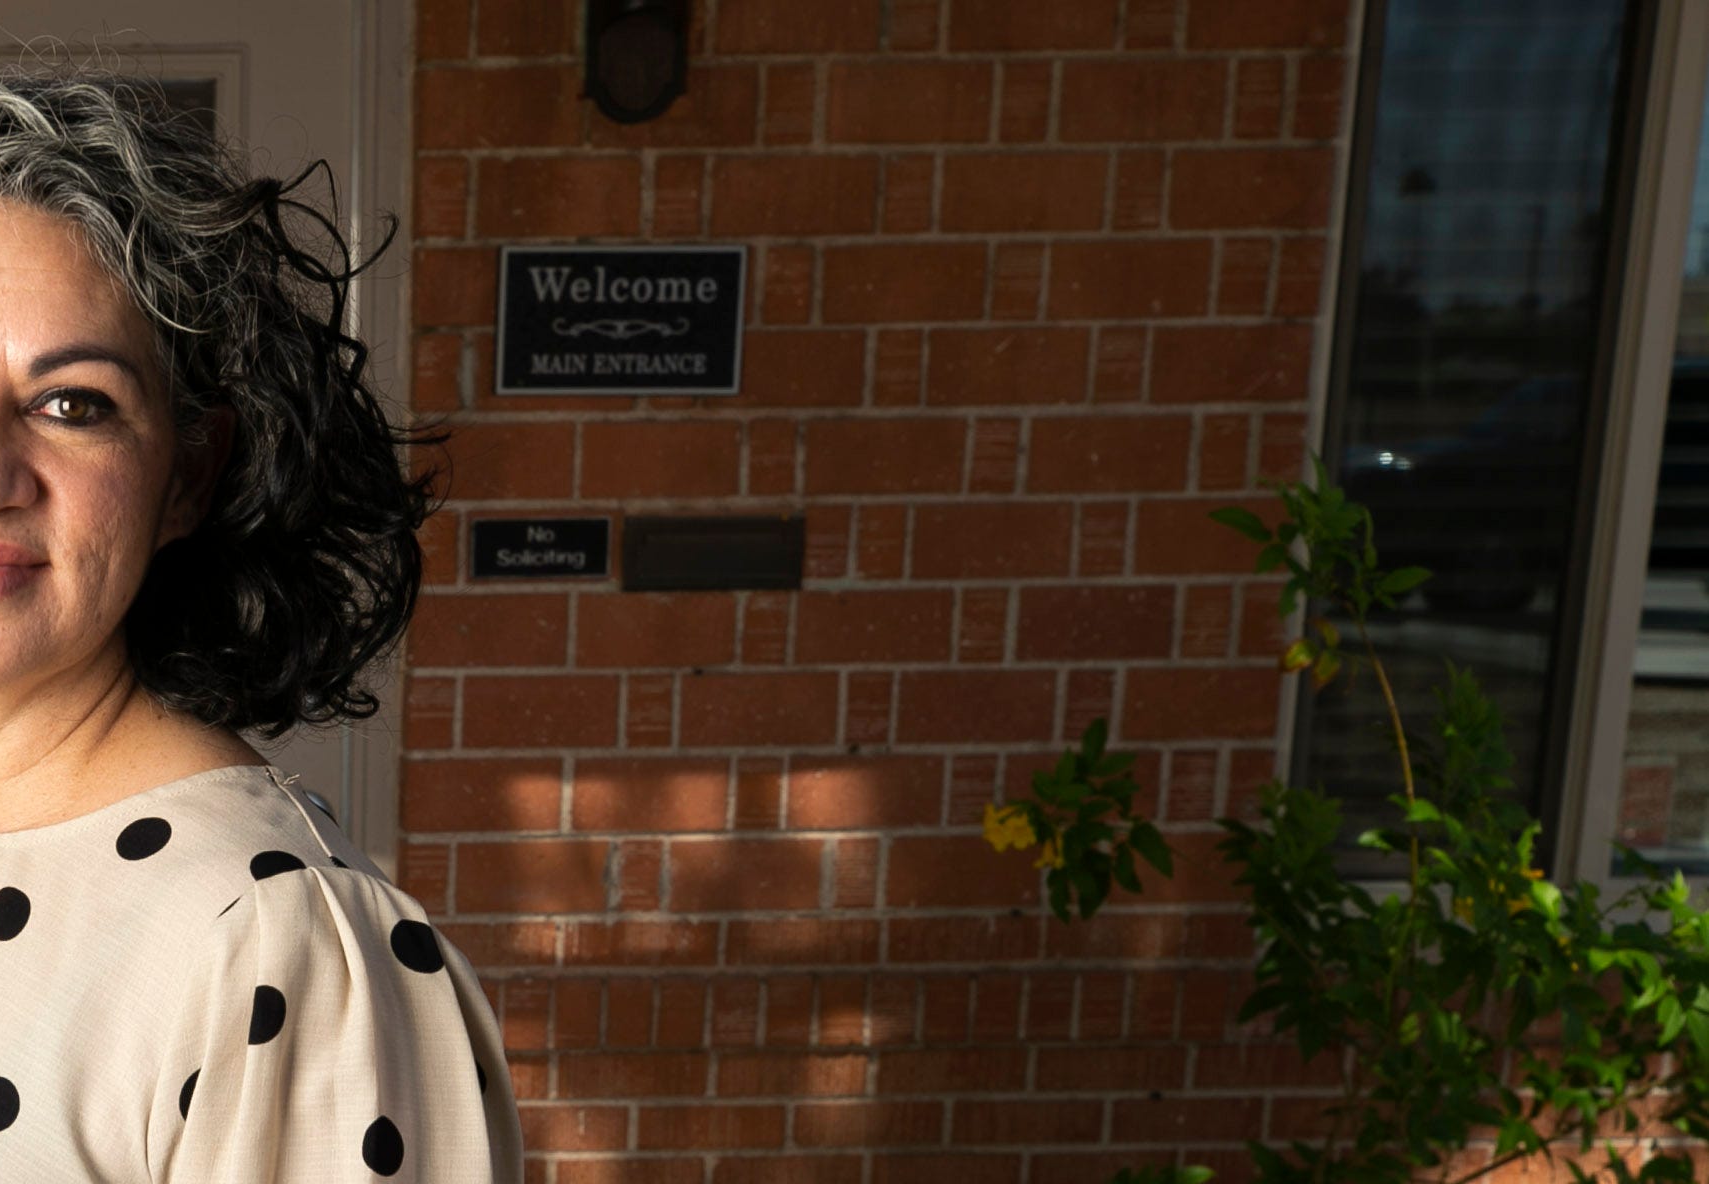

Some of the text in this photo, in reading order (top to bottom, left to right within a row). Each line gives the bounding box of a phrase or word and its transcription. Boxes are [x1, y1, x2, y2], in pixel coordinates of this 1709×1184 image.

[528, 265, 718, 303] Welcome
[530, 353, 707, 375] MAIN ENTRANCE
[527, 526, 555, 544] No
[496, 548, 586, 569] Soliciting
